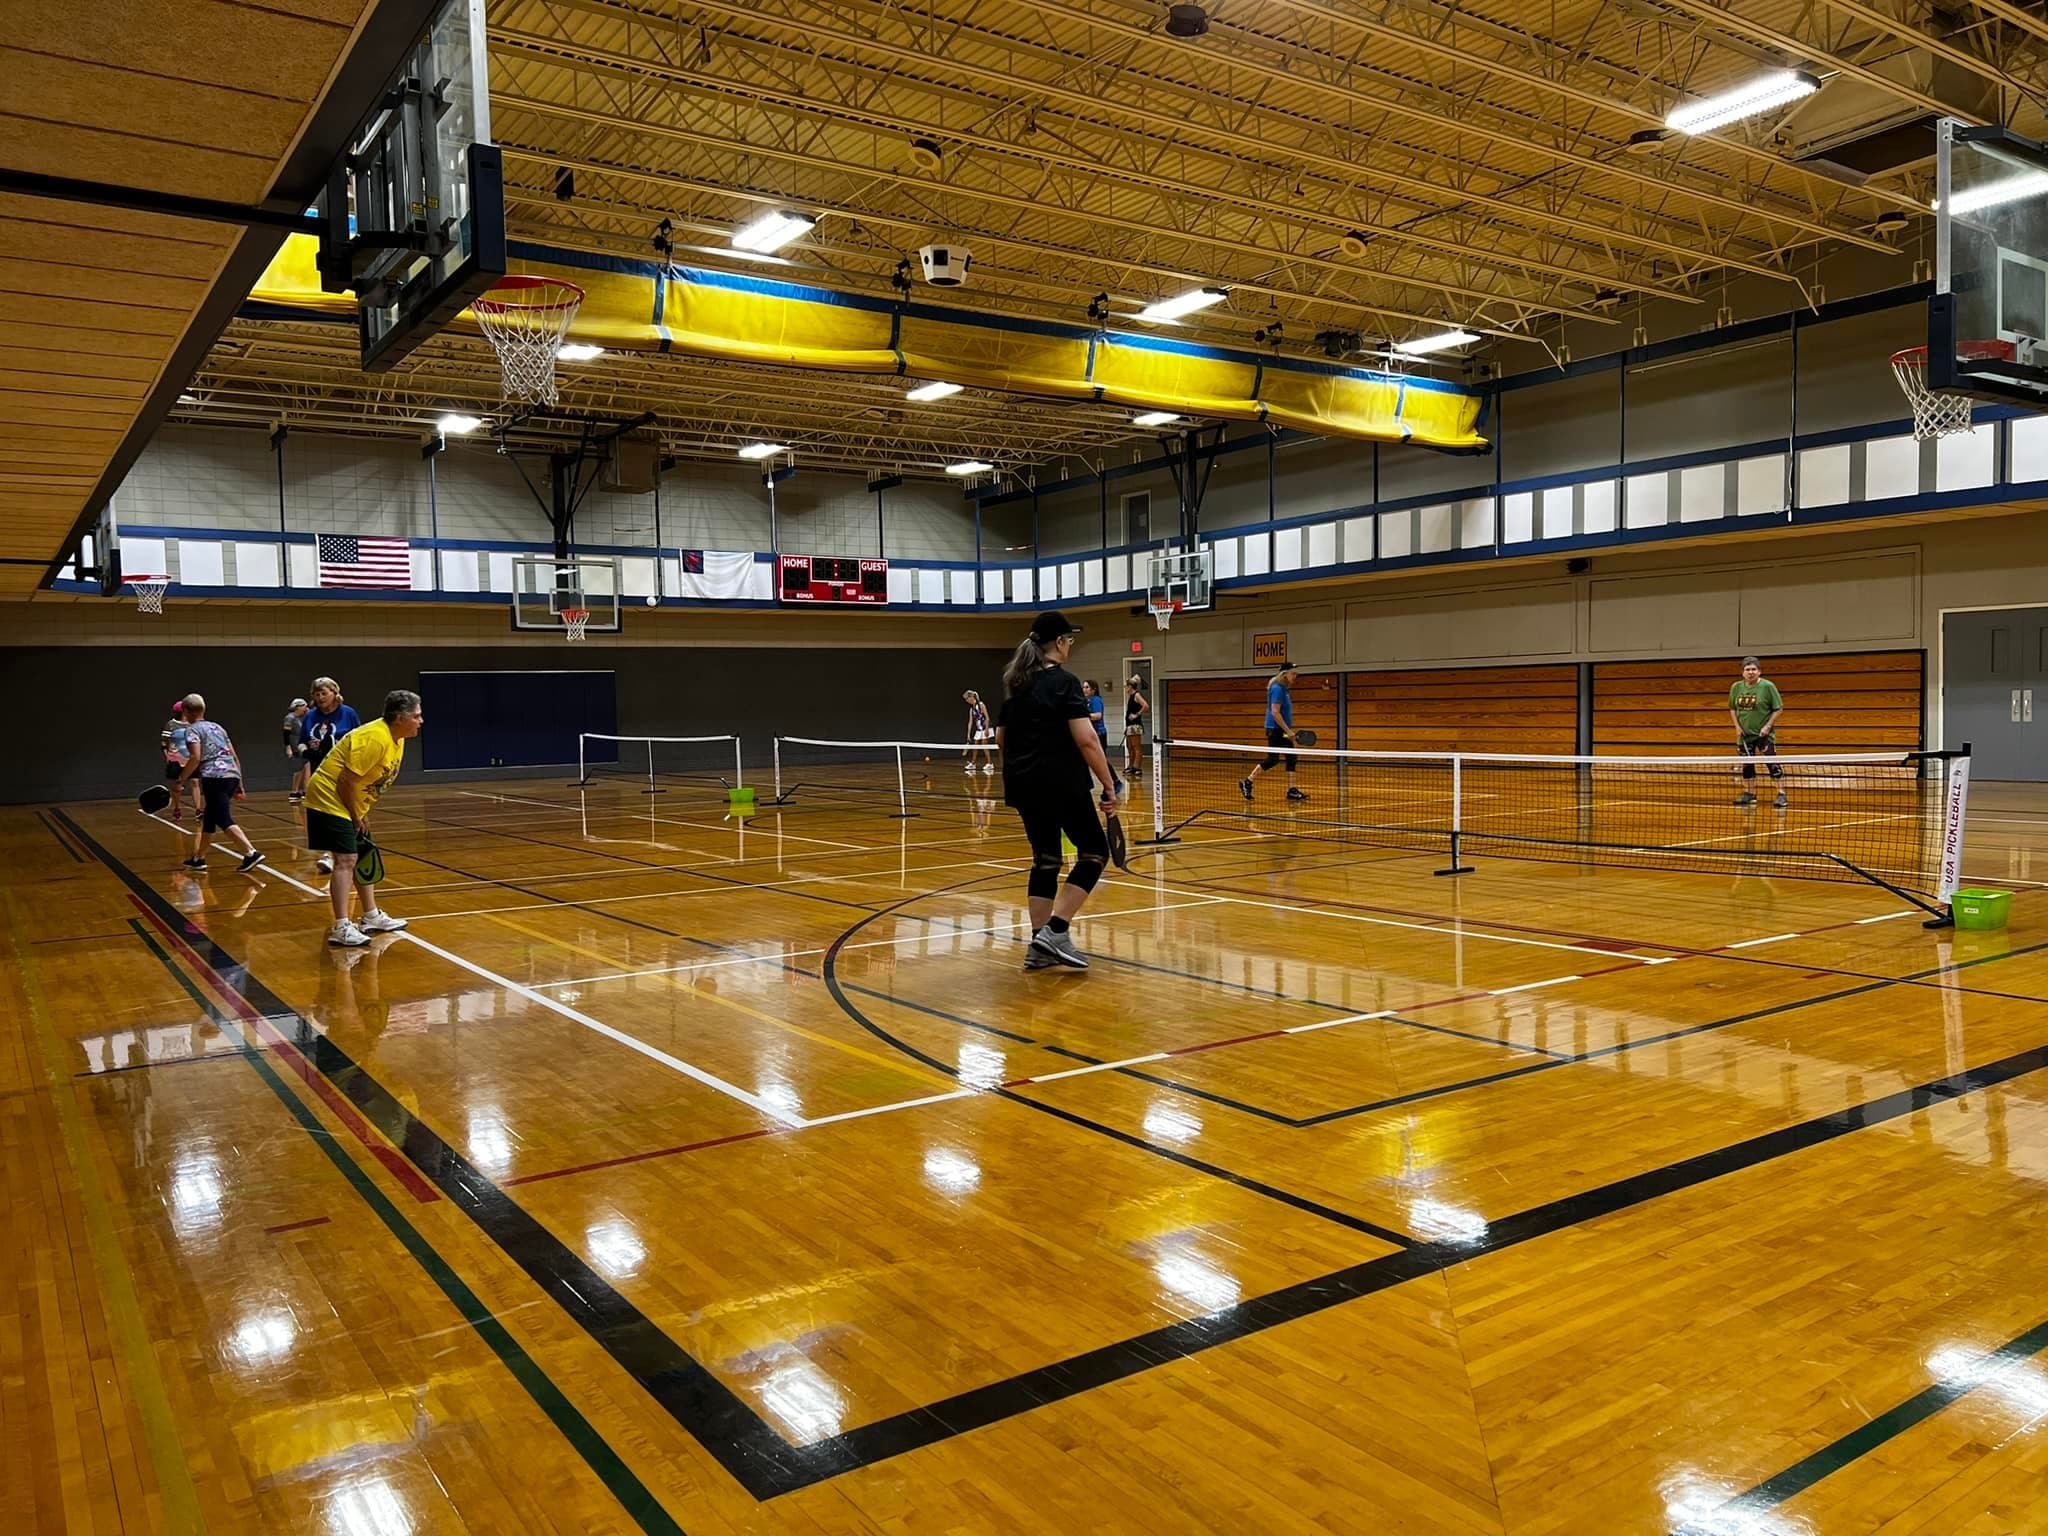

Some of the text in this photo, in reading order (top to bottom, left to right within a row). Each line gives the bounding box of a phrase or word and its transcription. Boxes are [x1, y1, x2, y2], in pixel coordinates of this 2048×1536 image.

[783, 558, 809, 568] HOME
[861, 562, 887, 572] GUEST
[1256, 641, 1285, 657] HOME
[1945, 783, 1962, 884] USA PICKLEBALL
